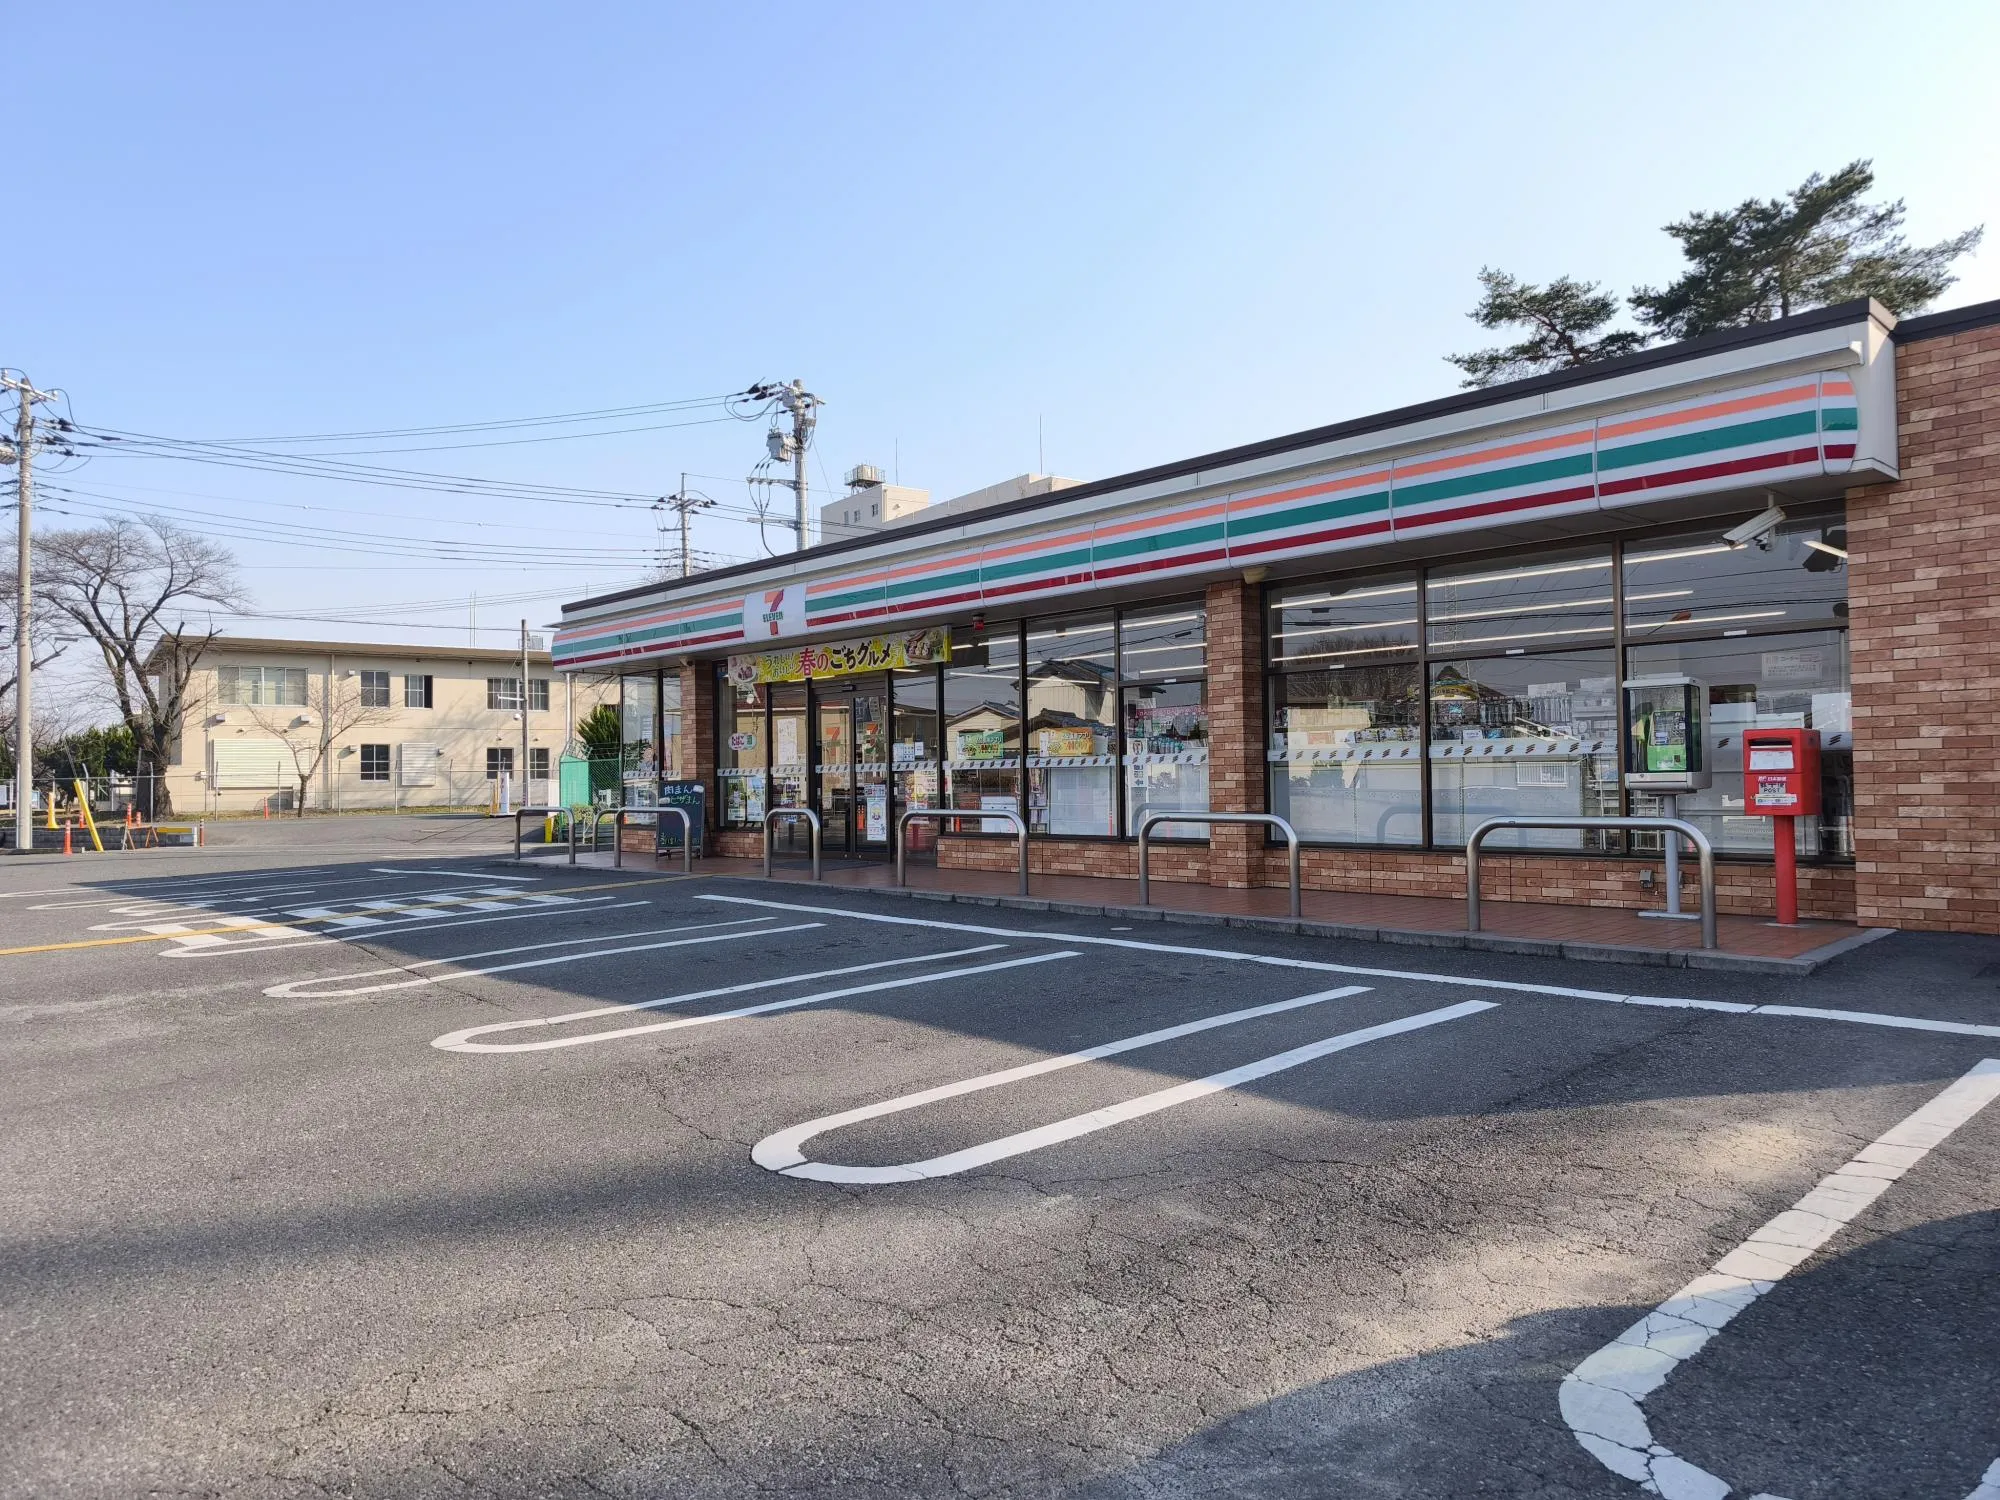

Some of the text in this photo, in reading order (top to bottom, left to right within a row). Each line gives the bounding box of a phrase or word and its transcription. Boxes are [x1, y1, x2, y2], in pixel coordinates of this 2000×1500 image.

[795, 641, 891, 676] 春のごちグルメ
[664, 784, 693, 796] 肉まん
